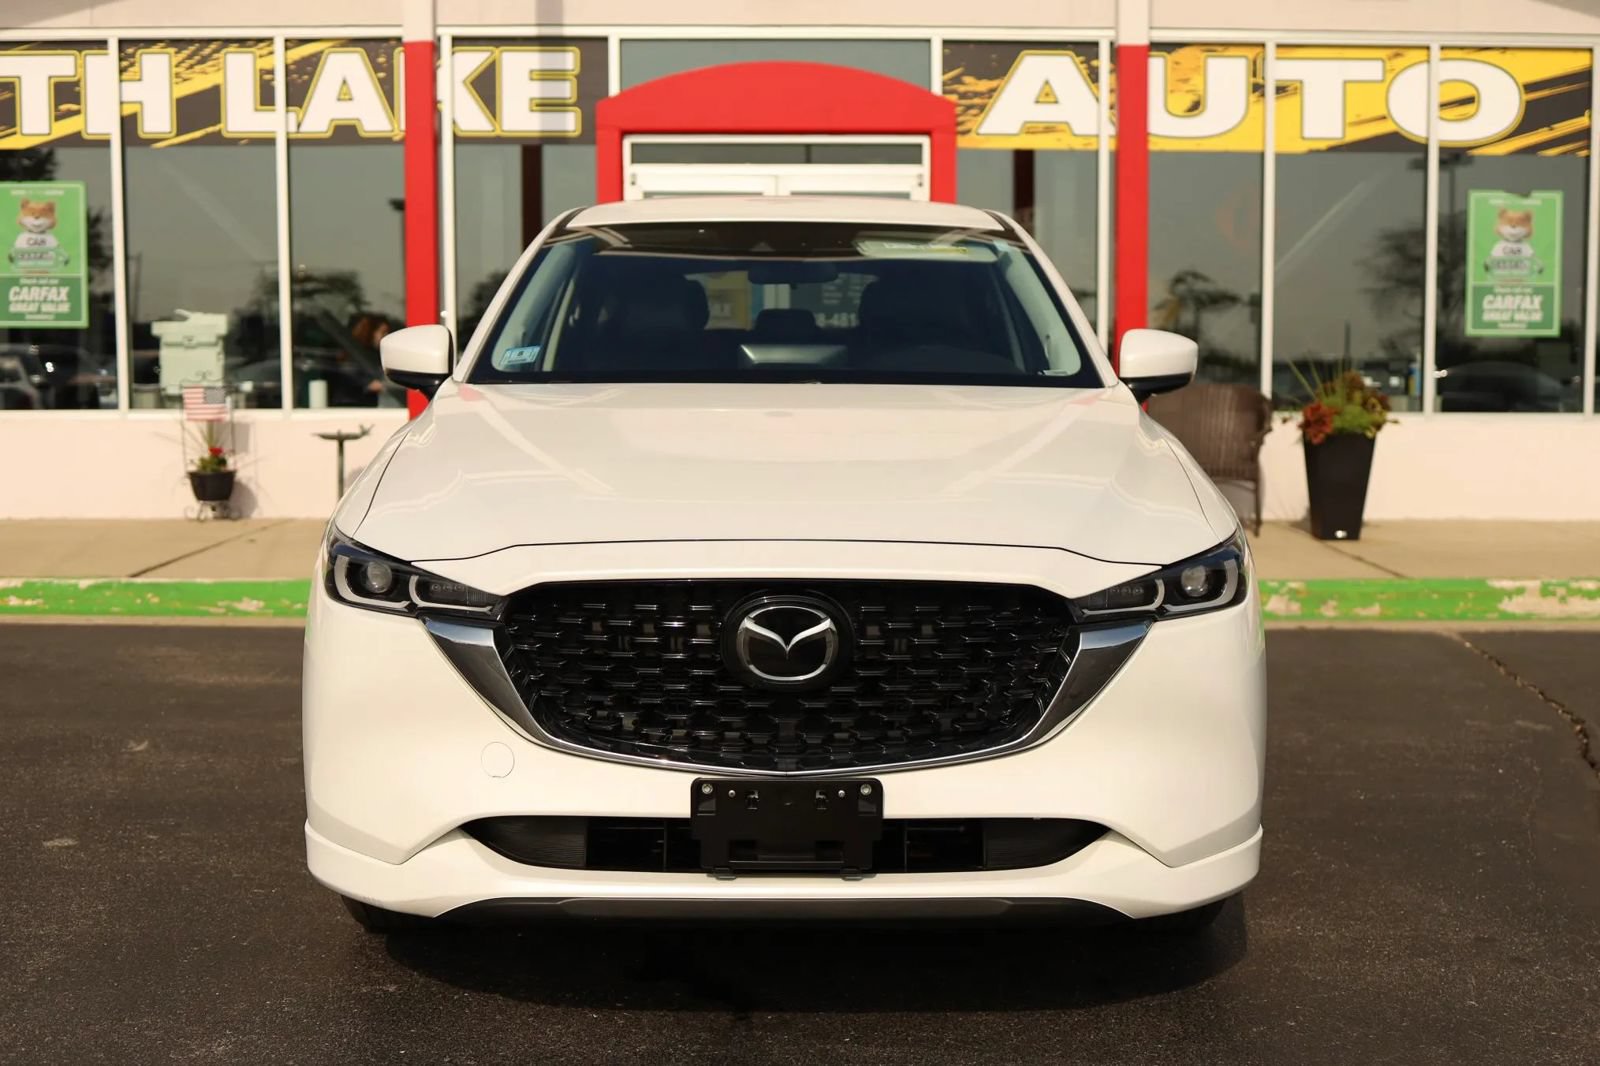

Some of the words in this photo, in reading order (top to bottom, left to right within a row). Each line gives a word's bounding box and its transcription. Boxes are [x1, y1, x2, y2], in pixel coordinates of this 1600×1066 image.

[222, 48, 581, 138] LAKE
[974, 50, 1524, 146] AUTO
[9, 286, 70, 302] CARFAX
[1483, 294, 1543, 309] CARFAX
